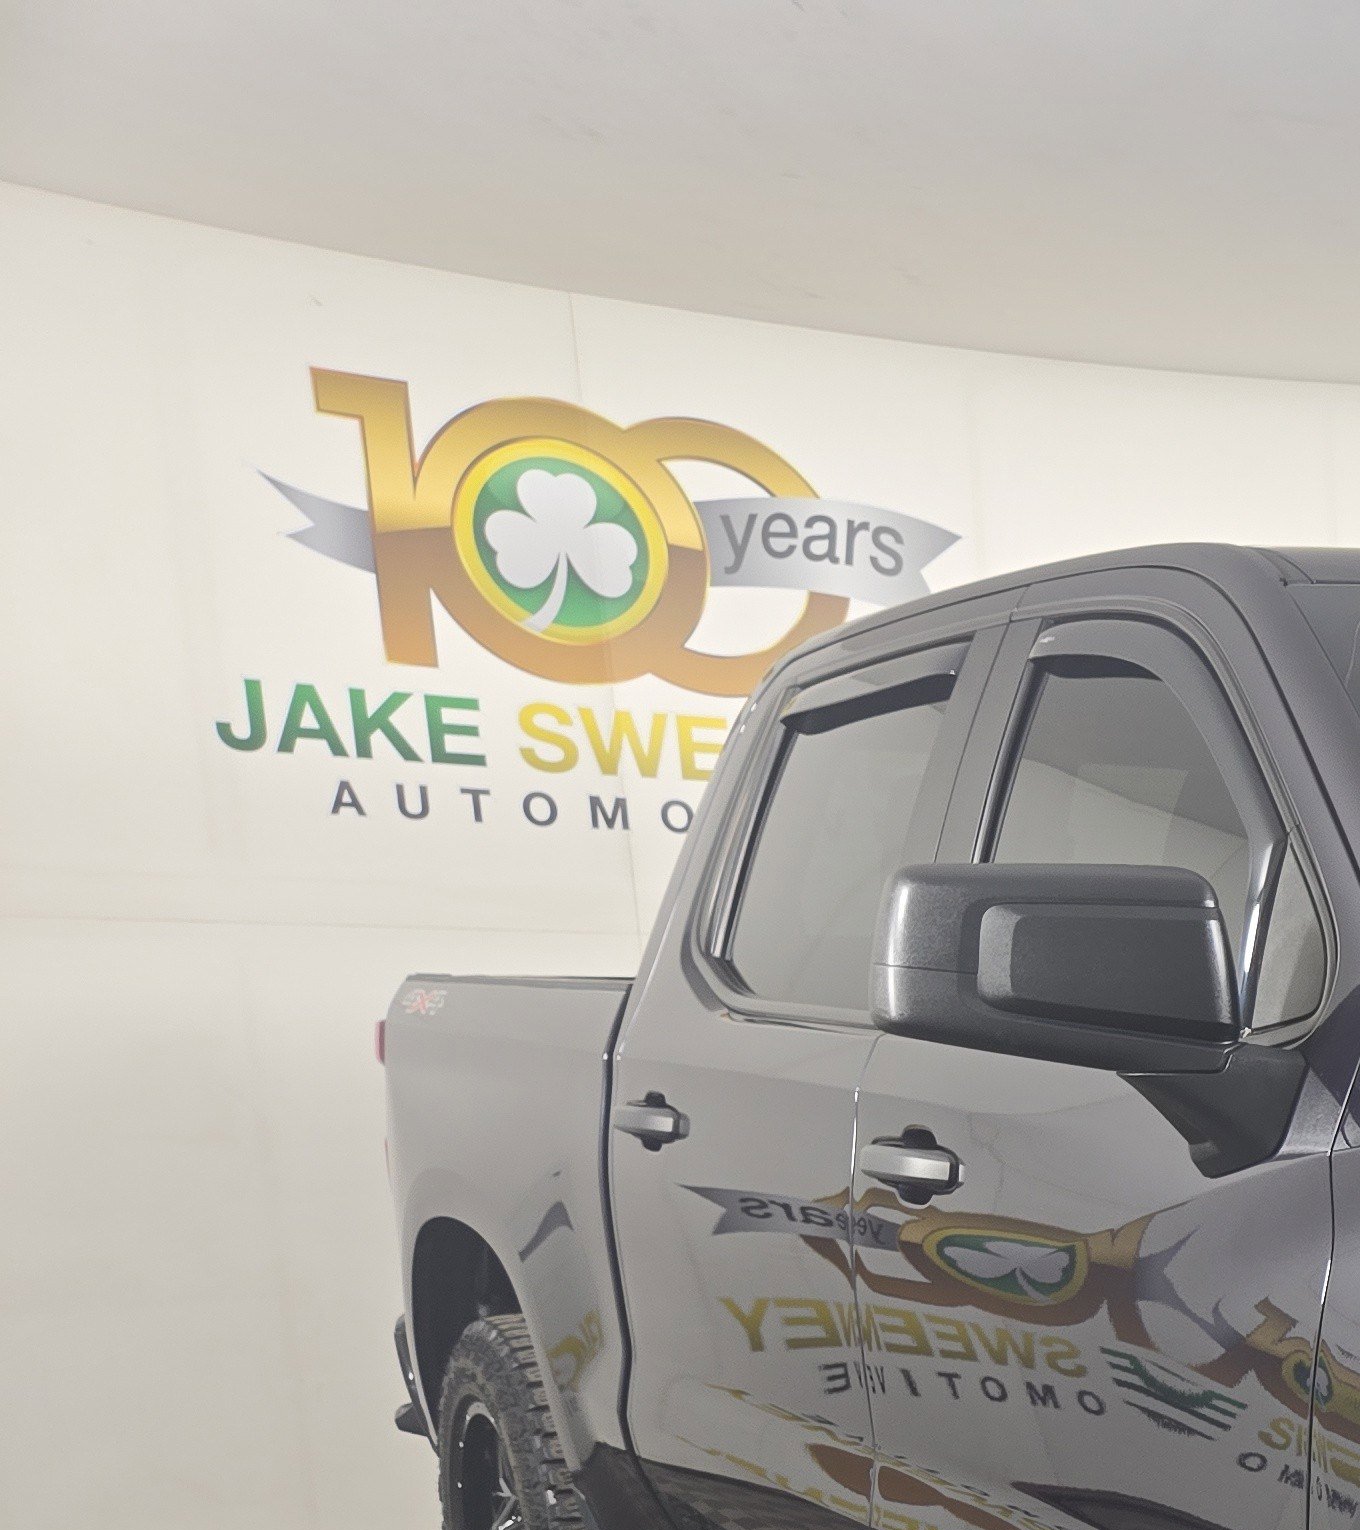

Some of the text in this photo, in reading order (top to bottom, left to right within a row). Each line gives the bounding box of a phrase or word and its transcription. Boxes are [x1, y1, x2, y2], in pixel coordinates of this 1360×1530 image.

[719, 511, 906, 578] years
[215, 677, 728, 781] JAKE SWE
[331, 780, 694, 833] AUTOMO
